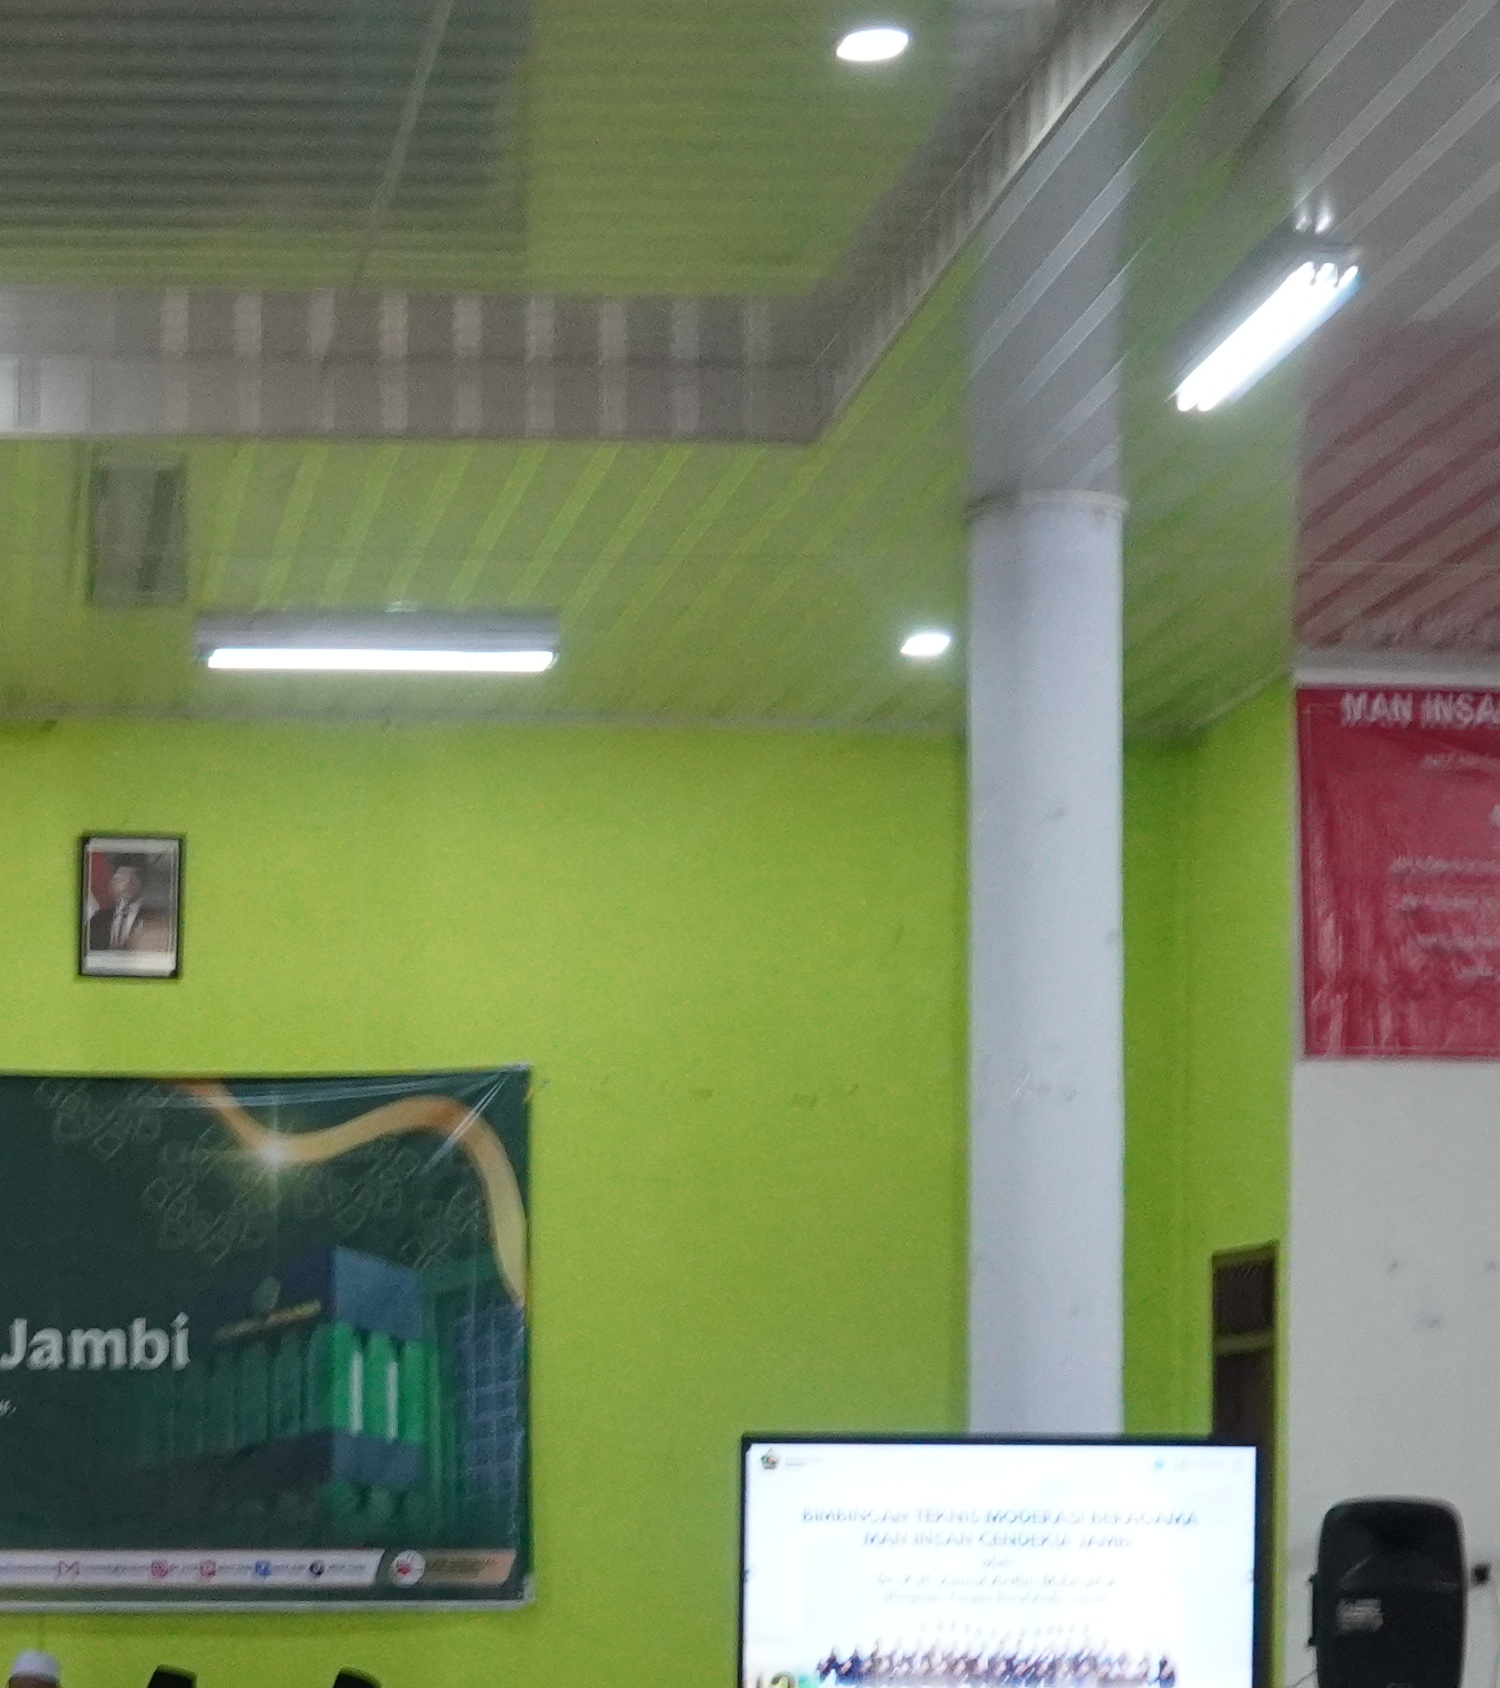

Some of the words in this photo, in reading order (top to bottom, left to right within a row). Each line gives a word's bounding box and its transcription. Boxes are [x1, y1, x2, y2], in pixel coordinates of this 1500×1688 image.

[1340, 691, 1414, 728] MAN
[801, 1507, 909, 1524] BIMBINGAN
[914, 1507, 981, 1525] TEKNIS
[984, 1508, 1086, 1526] MODERASI
[1089, 1510, 1199, 1528] BERAGAMA
[862, 1529, 909, 1547] MAN
[913, 1530, 974, 1547] INSAN
